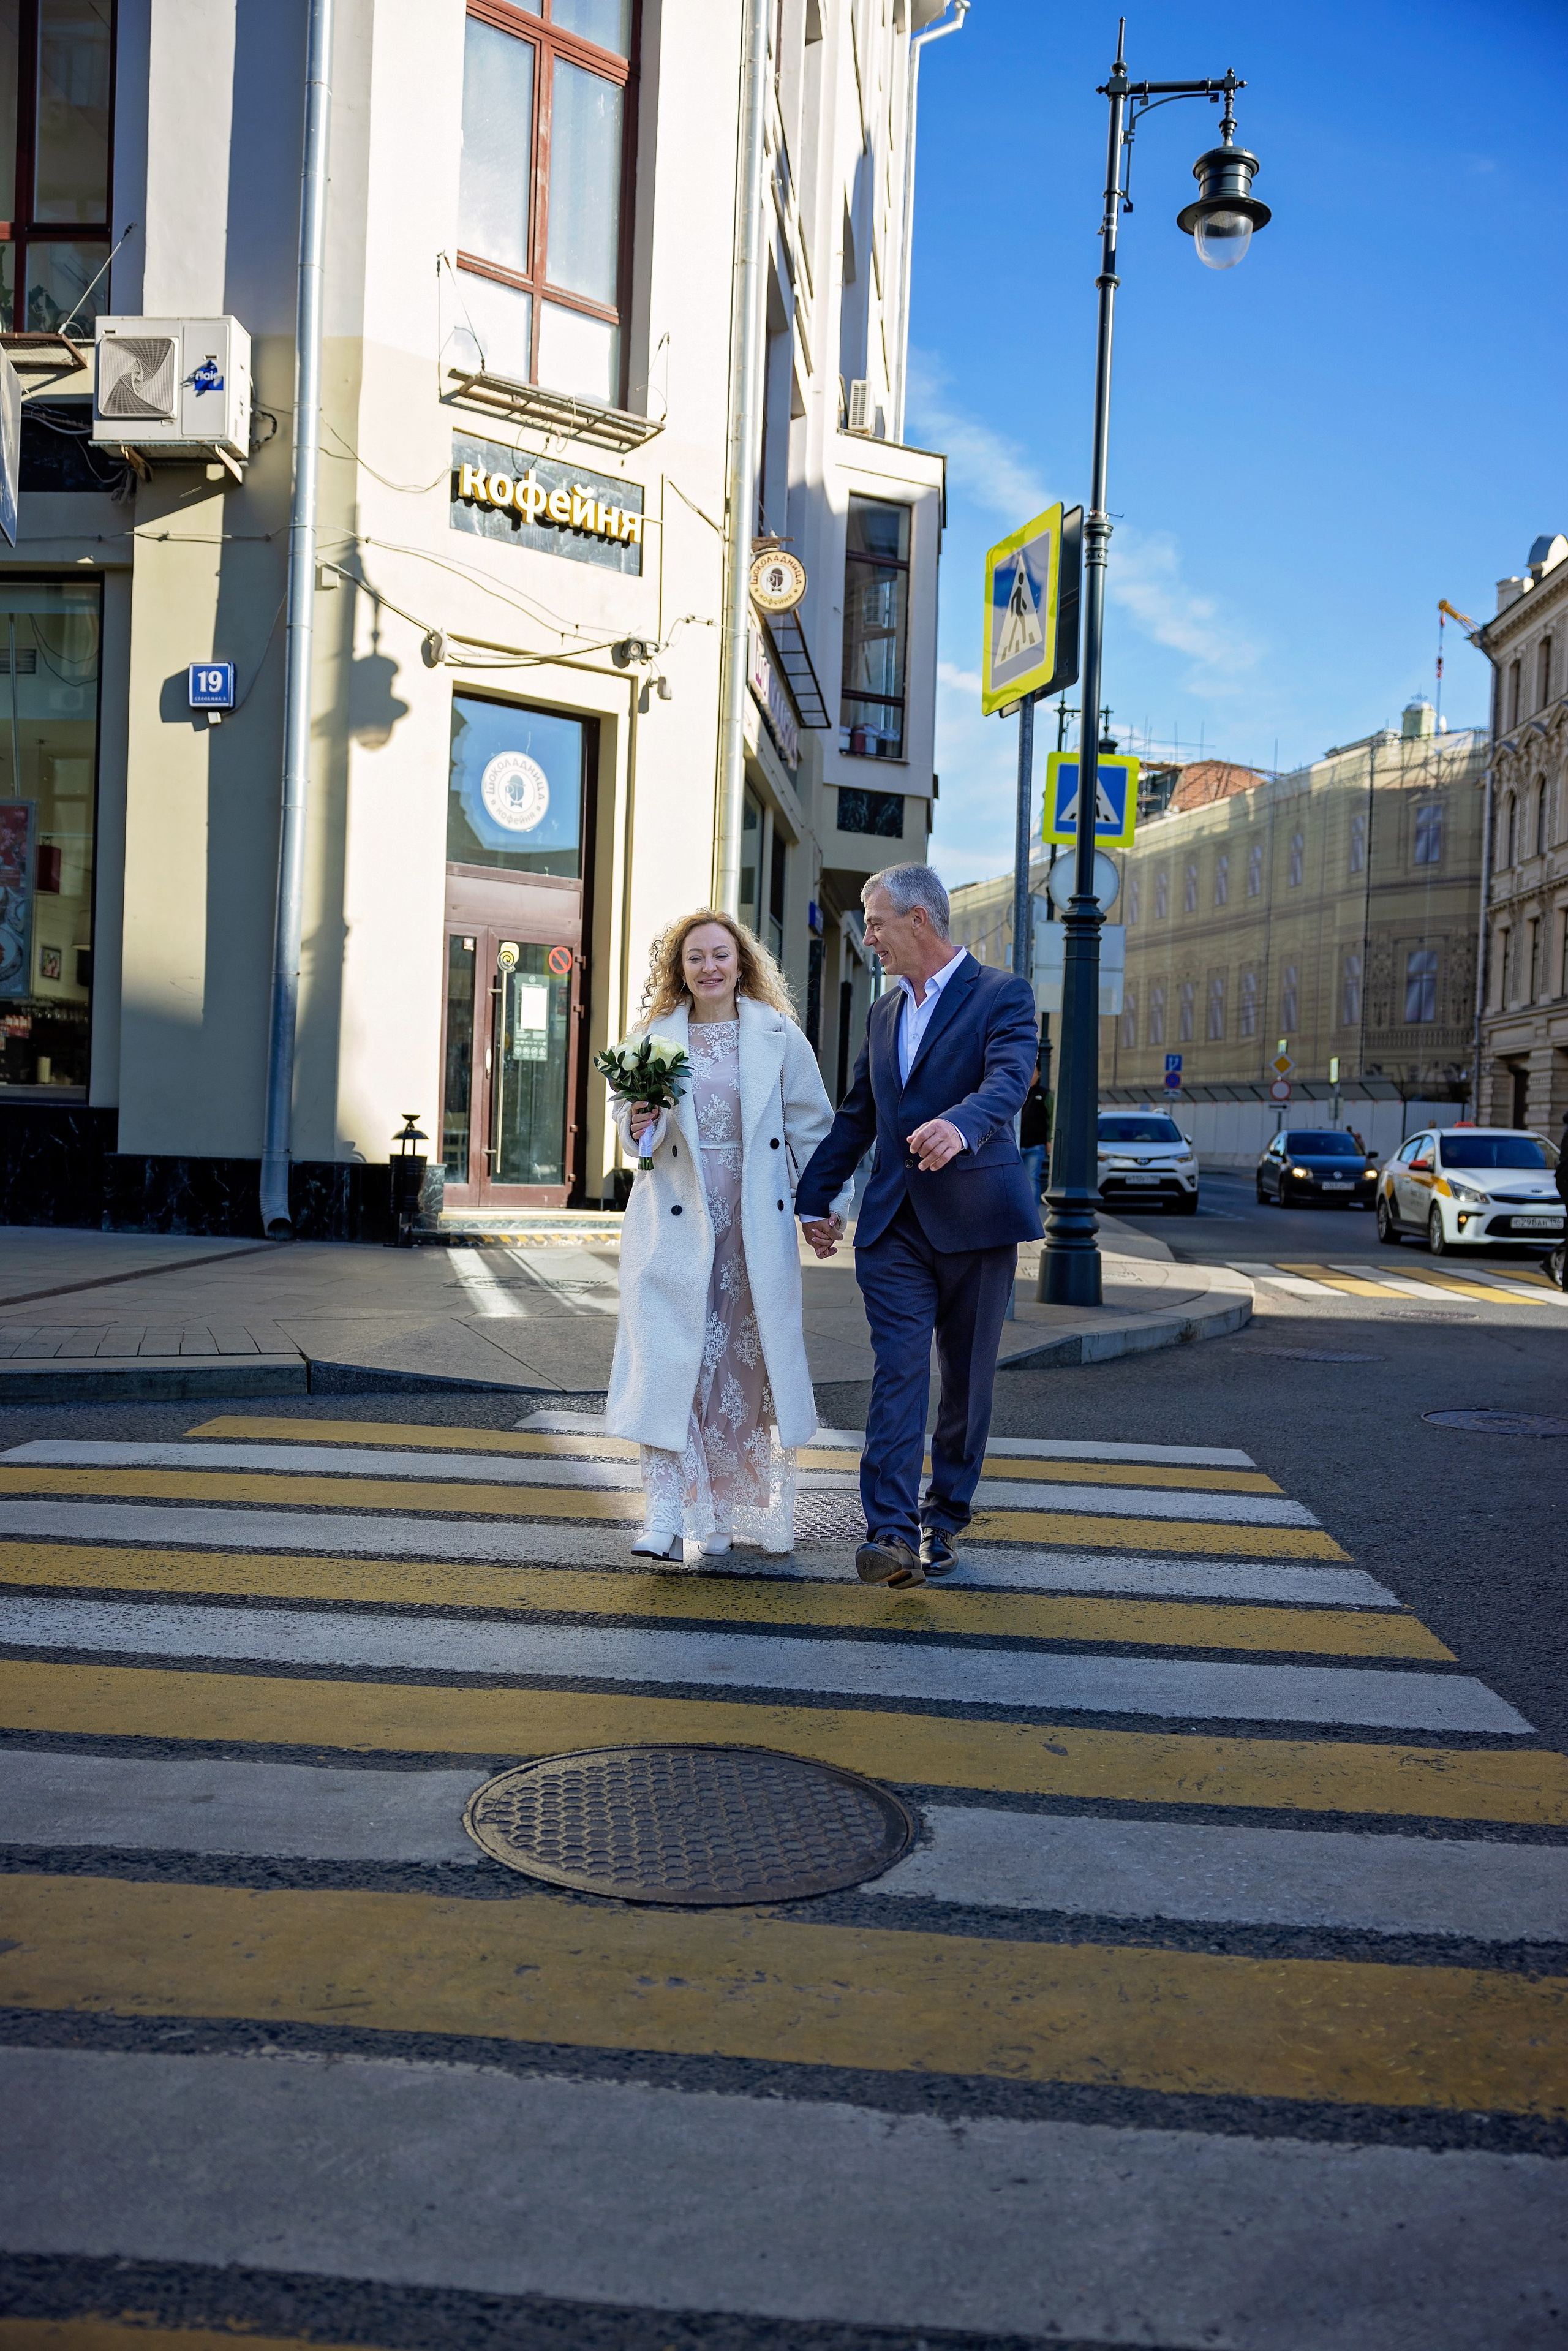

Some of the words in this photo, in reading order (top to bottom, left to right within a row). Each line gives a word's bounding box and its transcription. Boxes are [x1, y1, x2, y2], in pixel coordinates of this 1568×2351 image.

[459, 463, 643, 543] кофейня
[750, 554, 802, 584] ШОКОЛАДНИЦА
[758, 594, 793, 605] кофейня
[197, 670, 222, 693] 19
[486, 758, 545, 800] ШОКОЛАДНИЦА
[496, 807, 536, 825] кофейня
